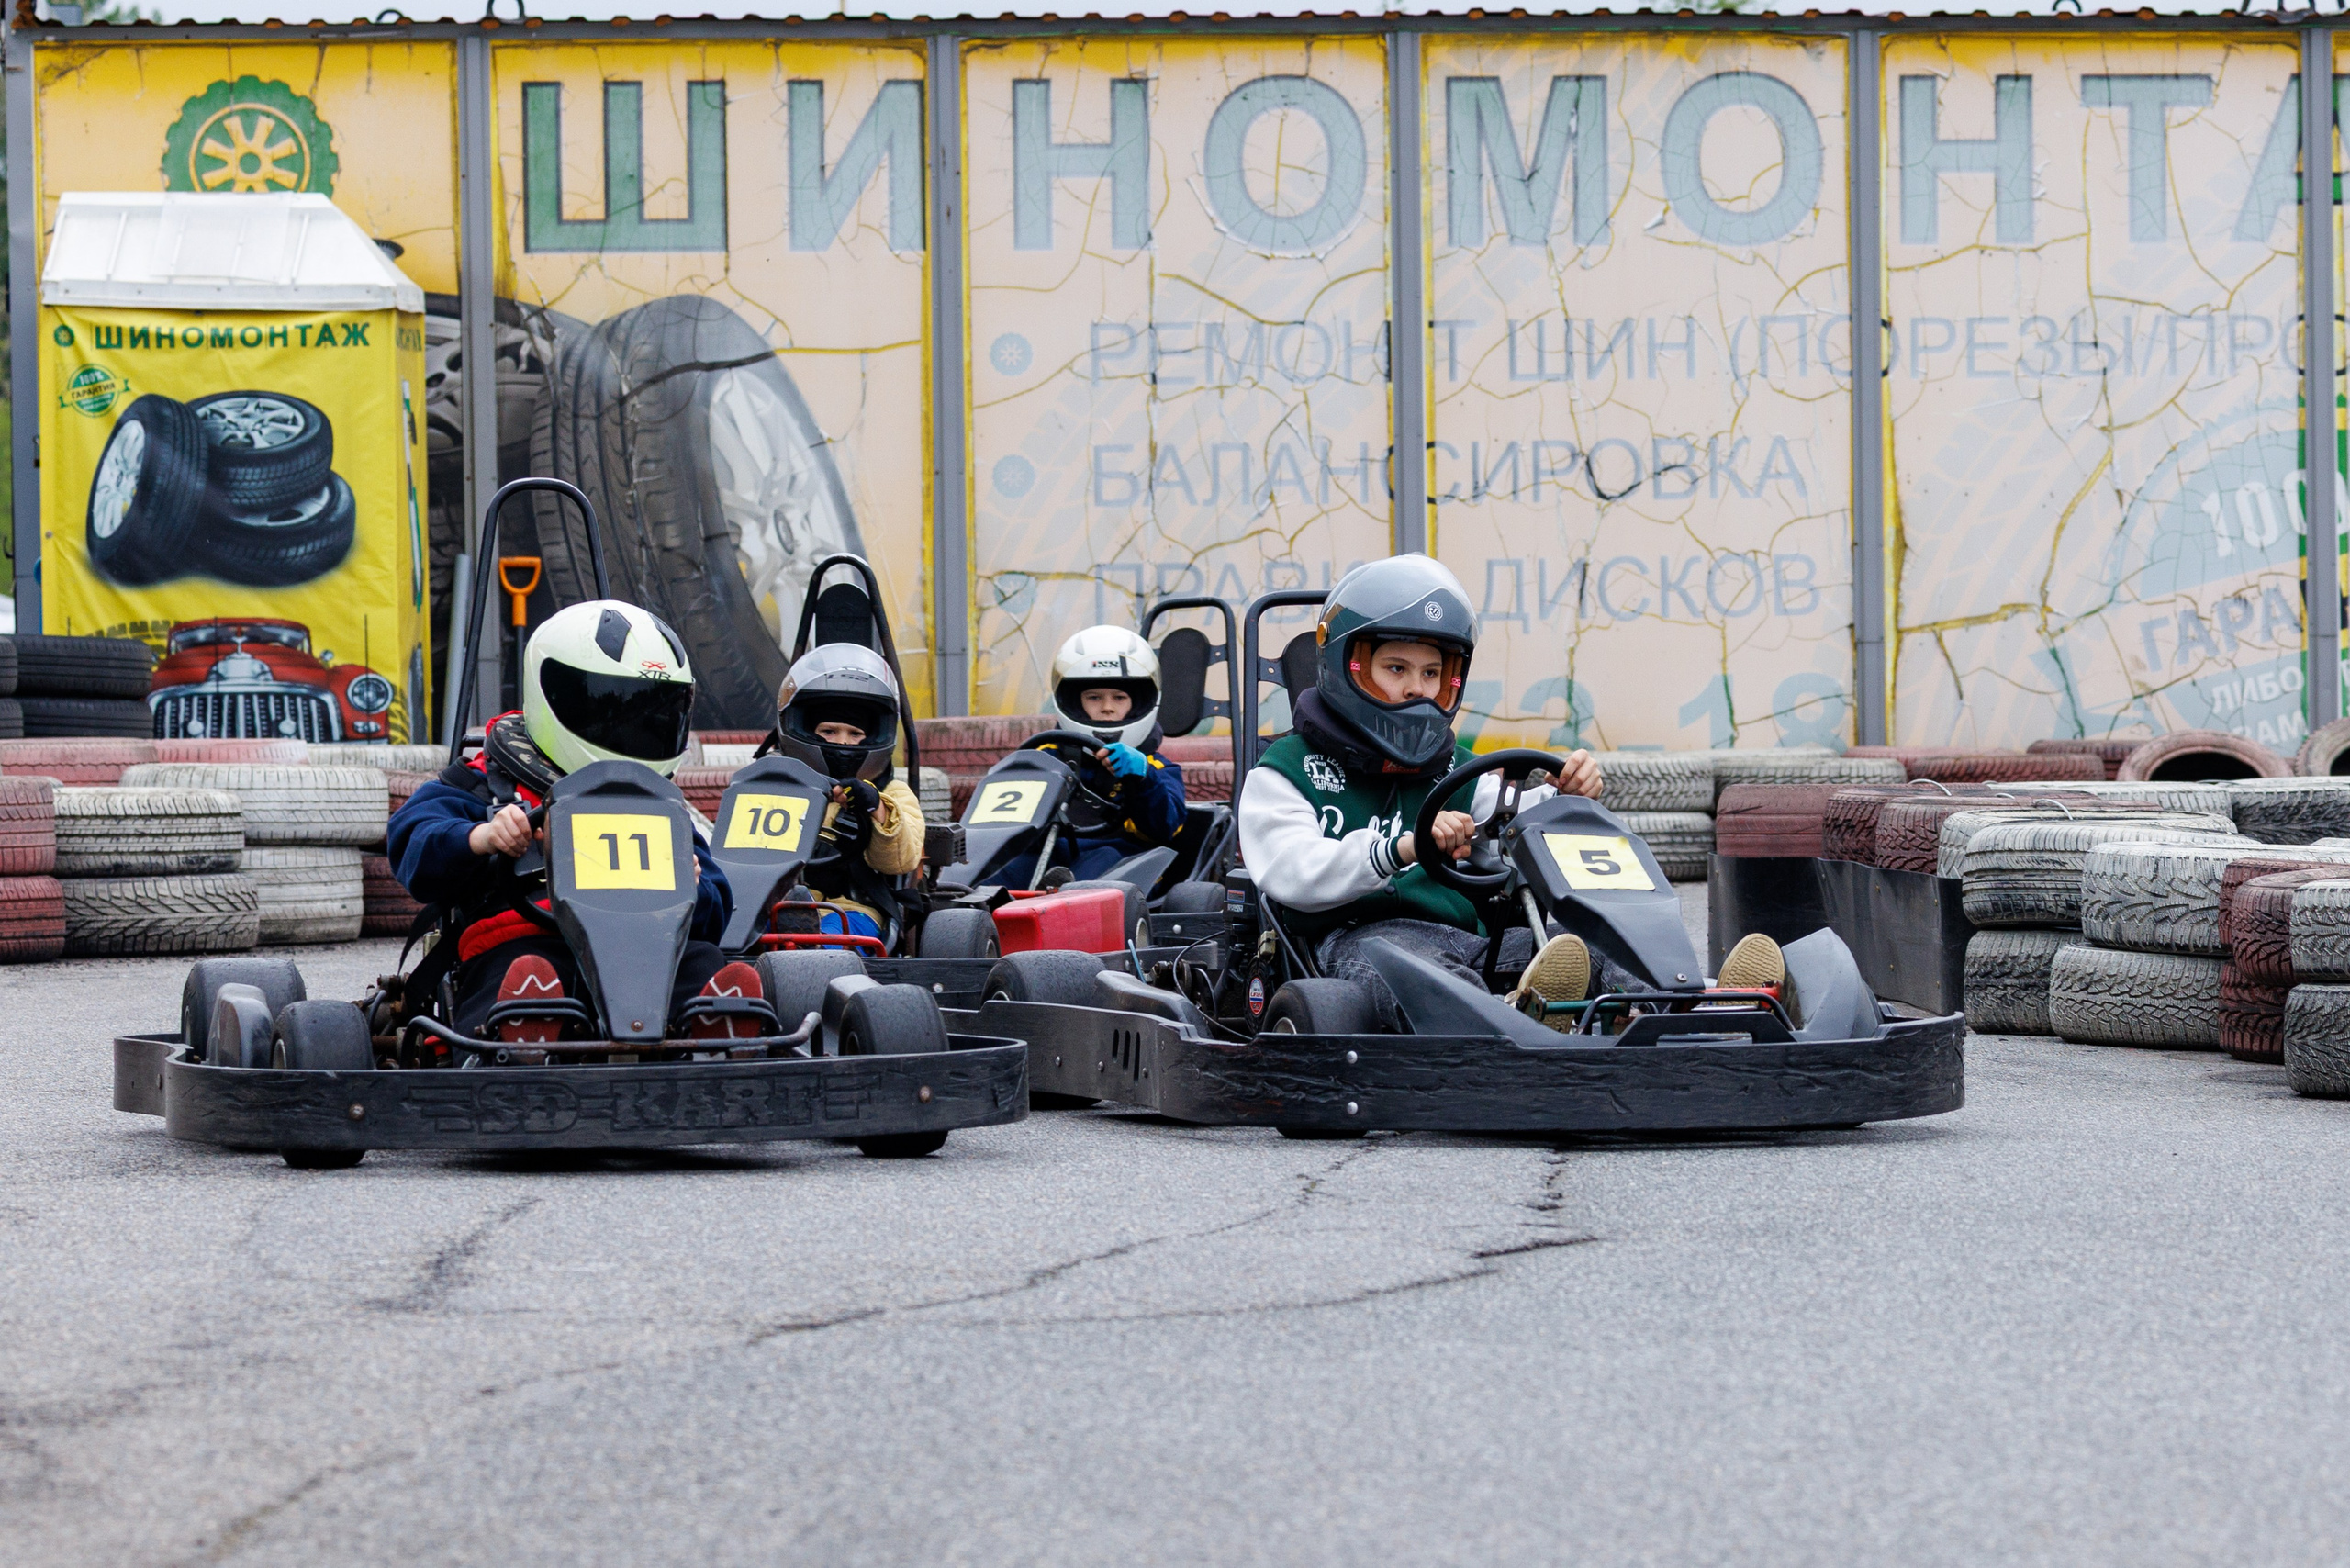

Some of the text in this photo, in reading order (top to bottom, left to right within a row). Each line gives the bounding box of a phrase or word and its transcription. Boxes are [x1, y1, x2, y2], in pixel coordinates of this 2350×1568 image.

[94, 322, 372, 351] ШИНОМОНТАЖ
[1090, 319, 1476, 385] РЕМОНТ
[1507, 317, 1695, 382] ШИН
[1094, 435, 1807, 509] БАЛАНСИРОВКА
[1095, 553, 1822, 635] ПРАВ ДИСКОВ
[2139, 582, 2308, 673] ГАРА
[2211, 666, 2304, 714] ЛИБО
[1309, 761, 1339, 784] LA
[1326, 756, 1346, 778] LEAGUE
[990, 790, 1023, 812] 2
[747, 808, 791, 836] 10
[598, 833, 650, 871] 11
[1579, 849, 1621, 876] 5
